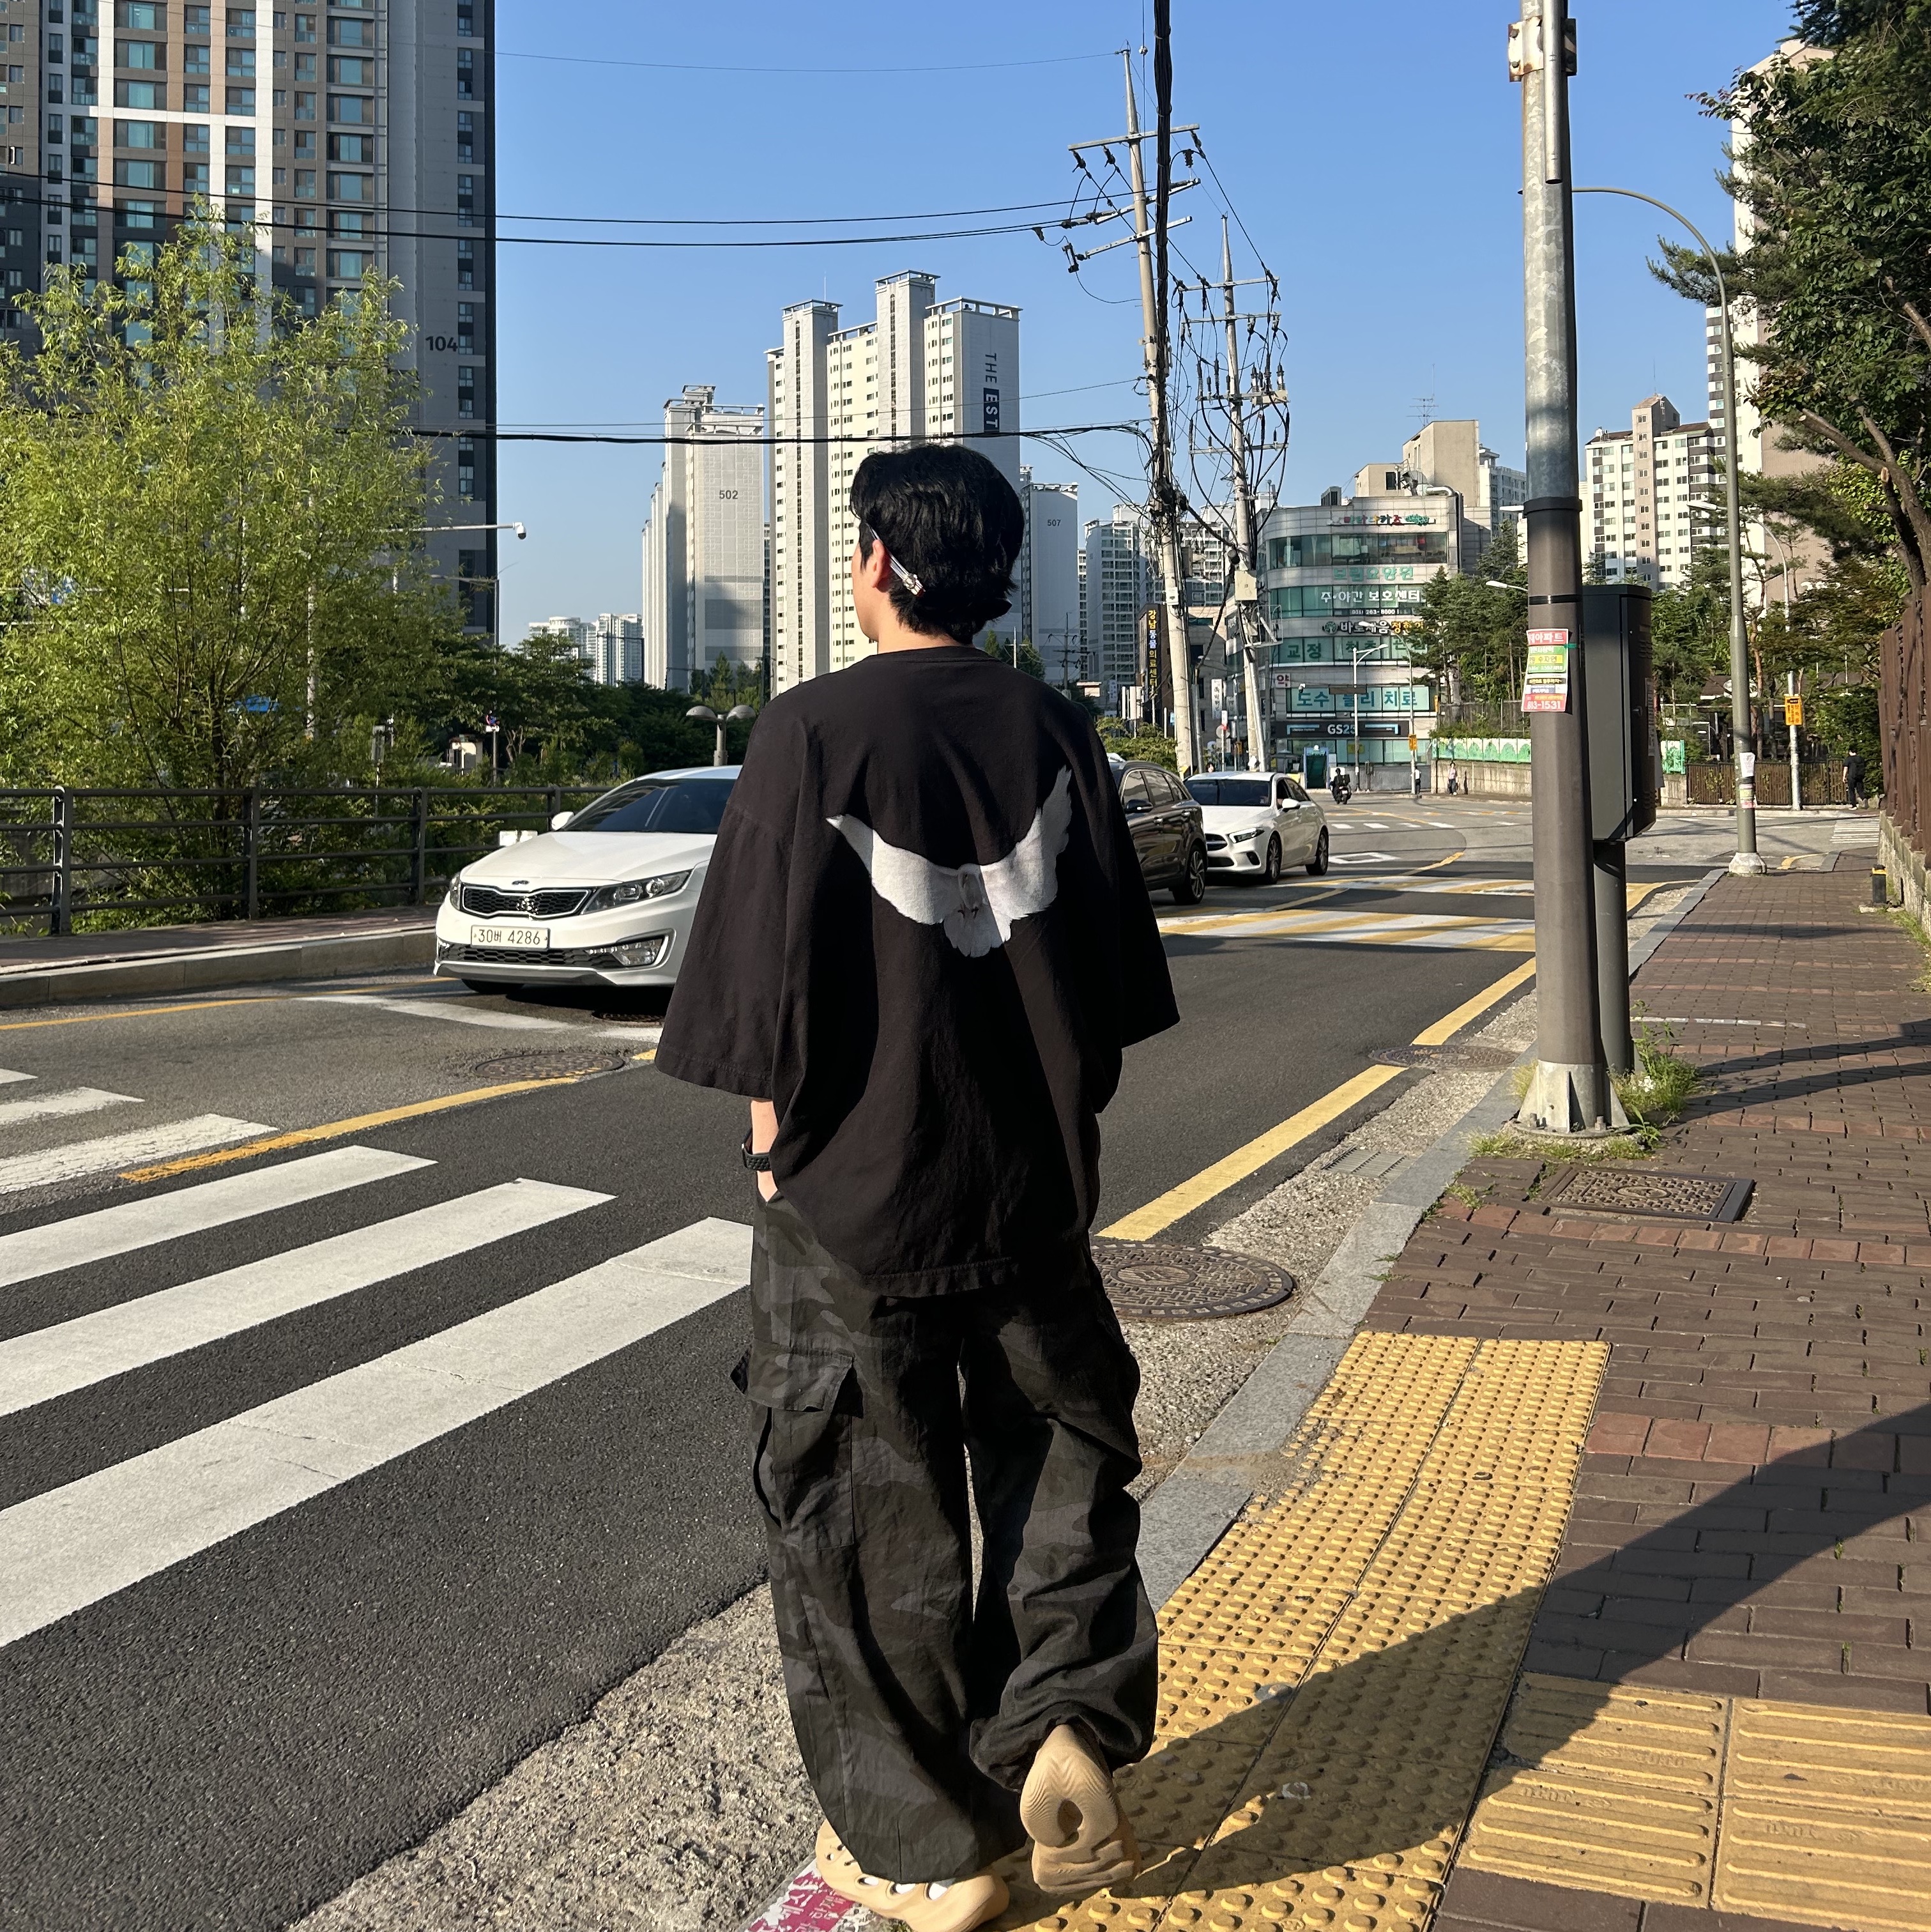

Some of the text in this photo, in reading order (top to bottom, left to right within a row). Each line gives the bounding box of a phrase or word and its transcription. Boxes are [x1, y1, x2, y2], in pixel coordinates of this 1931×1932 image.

[425, 335, 458, 352] 104
[984, 353, 998, 429] THE EST
[719, 489, 738, 500] 502
[1047, 519, 1062, 527] 507
[1368, 590, 1421, 603] 보호센터
[1287, 643, 1322, 659] 교정
[1276, 675, 1290, 687] 약
[1297, 691, 1330, 707] 도수
[1384, 691, 1417, 707] 치료
[1327, 724, 1356, 735] GS25
[478, 928, 540, 946] 30버 4286
